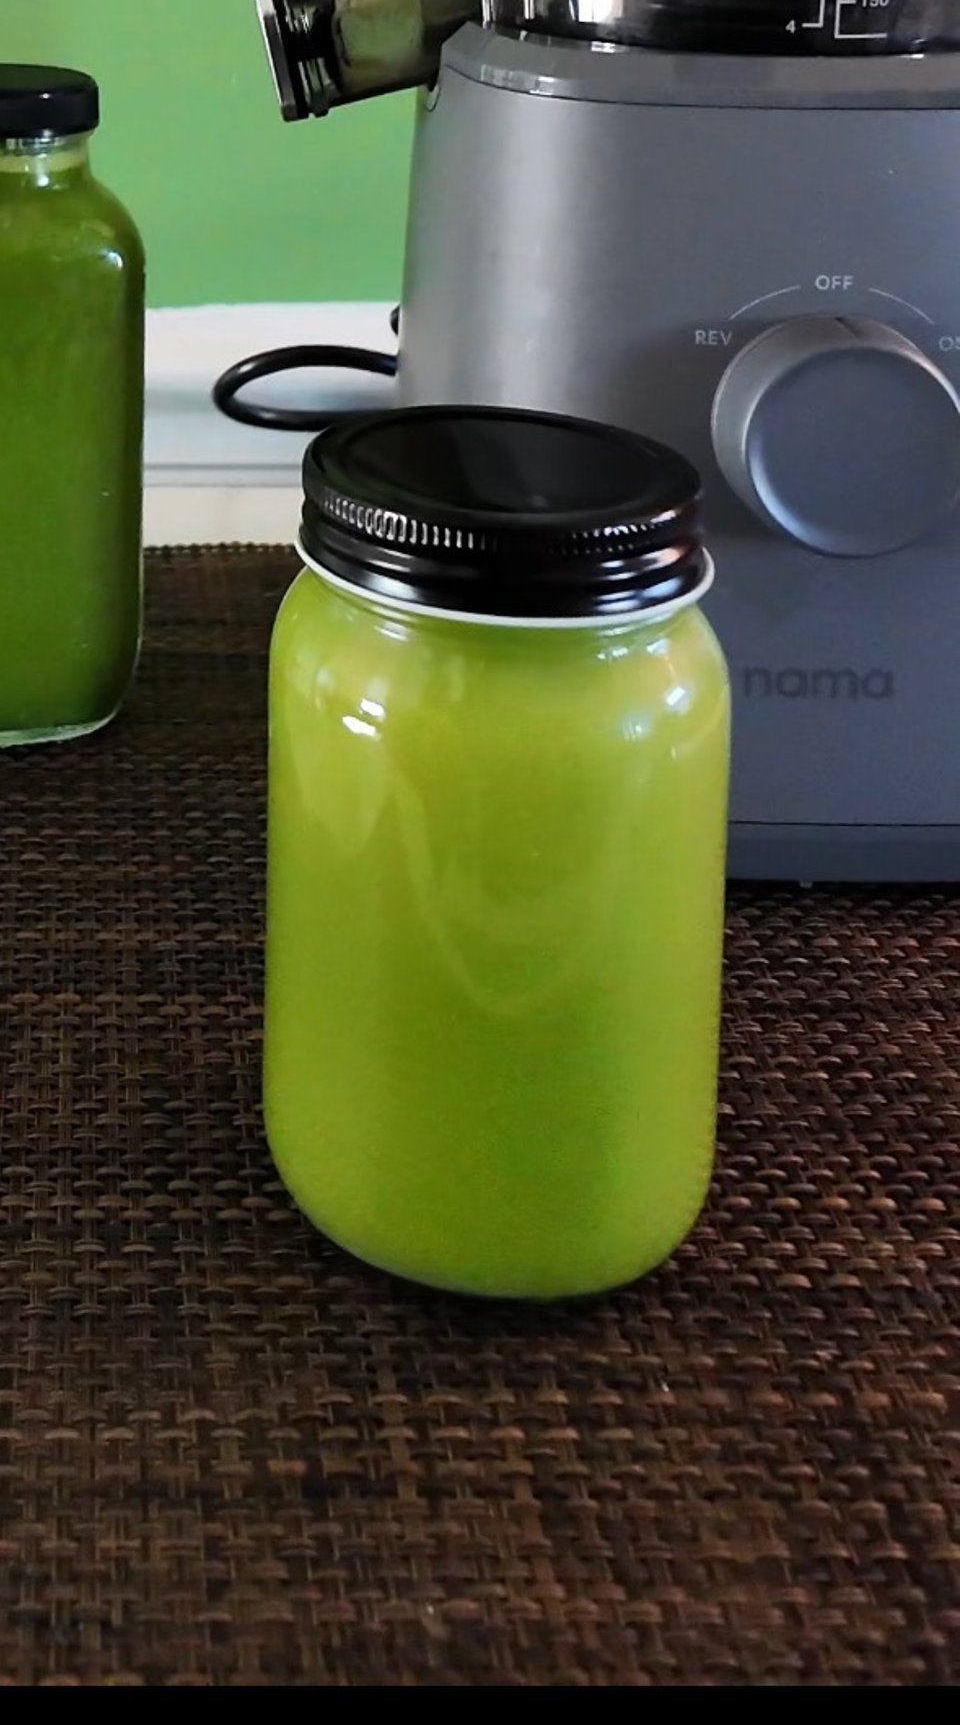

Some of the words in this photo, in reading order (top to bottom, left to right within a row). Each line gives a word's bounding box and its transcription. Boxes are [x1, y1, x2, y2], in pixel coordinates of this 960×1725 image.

[785, 19, 796, 34] 4
[815, 274, 853, 291] OFF
[695, 329, 733, 346] REV
[744, 666, 894, 699] nama
